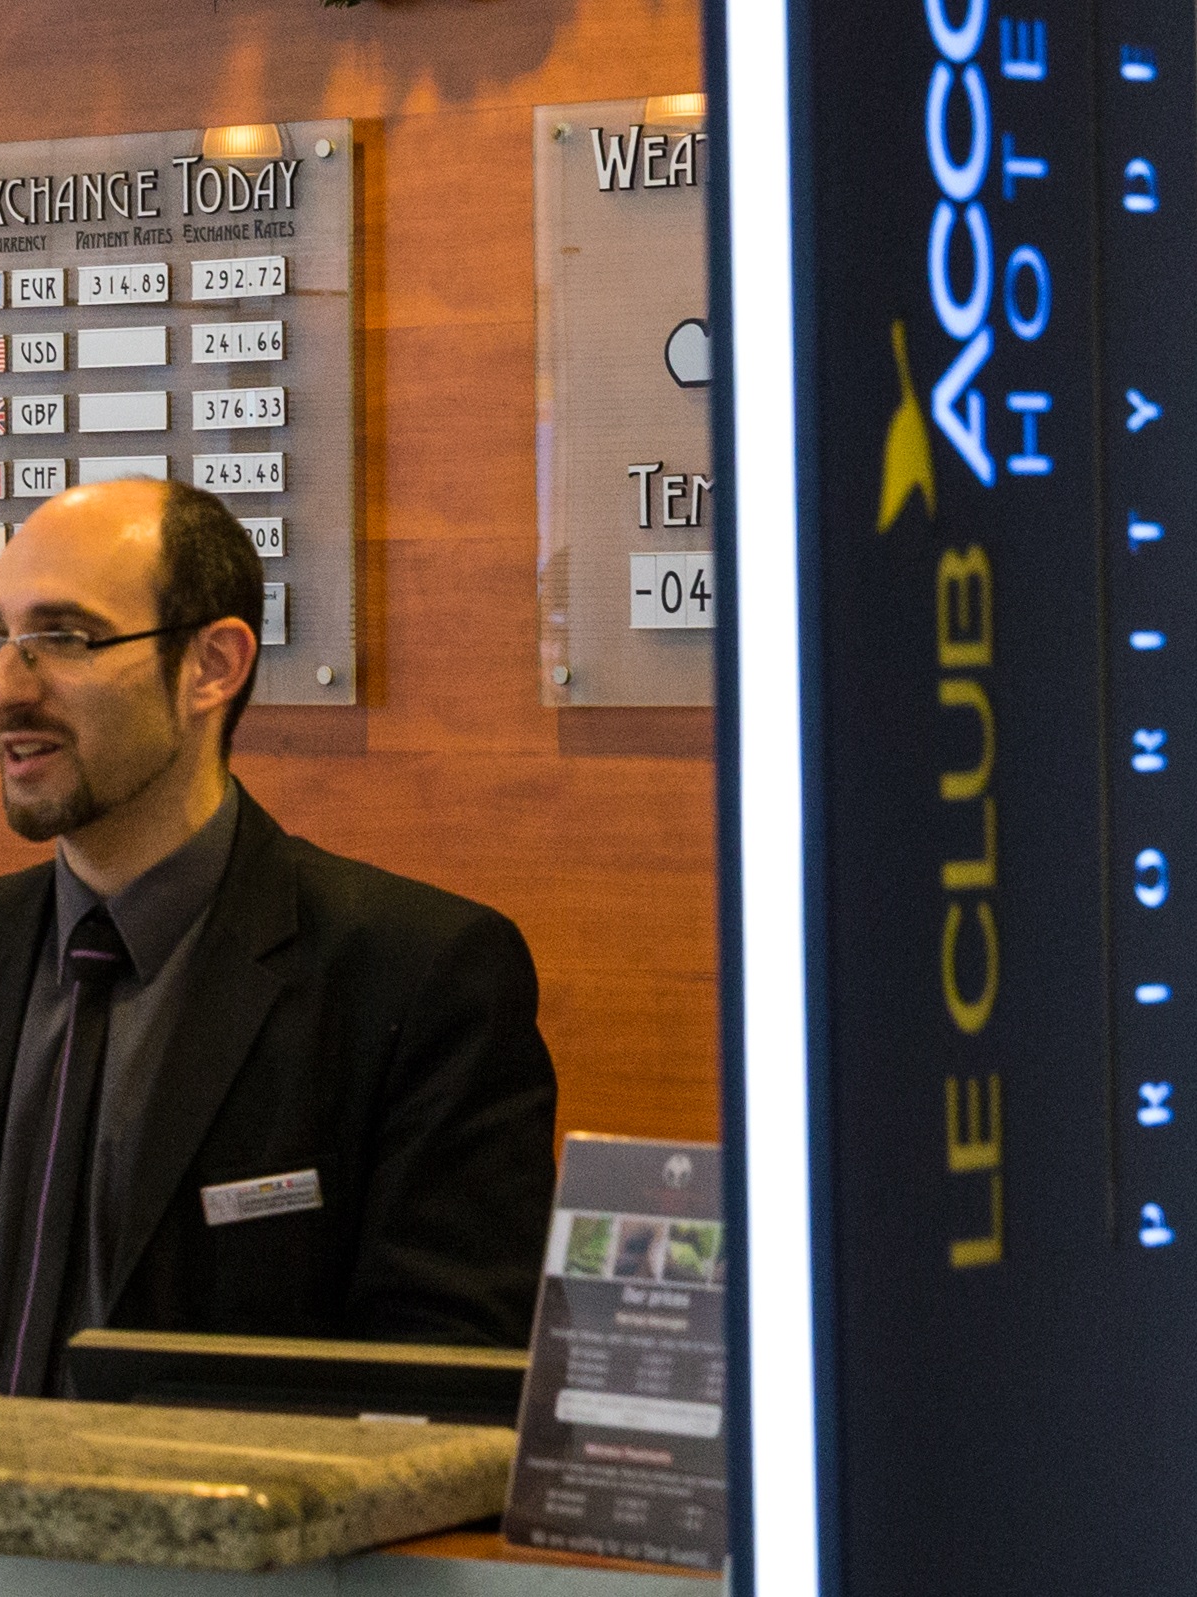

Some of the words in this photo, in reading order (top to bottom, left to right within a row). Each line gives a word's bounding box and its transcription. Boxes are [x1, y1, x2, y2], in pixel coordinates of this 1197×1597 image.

[589, 124, 707, 191] WEA
[173, 156, 302, 215] TODAY
[75, 230, 129, 250] PAYMENT
[133, 227, 173, 246] RATES
[183, 223, 250, 244] EXCHANGE
[254, 221, 295, 240] RATES
[20, 276, 56, 300] EUR
[92, 273, 166, 296] 314.89
[205, 267, 282, 290] 292.72
[21, 341, 57, 365] USD
[205, 332, 282, 354] 241.66
[22, 402, 57, 427] GBP
[205, 397, 282, 421] 376.33
[22, 467, 57, 490] CHF
[205, 462, 280, 484] 243.48
[936, 544, 1000, 1034] CLUB
[1125, 387, 1175, 1247] PRIORITY
[945, 1074, 1001, 1269] LE
